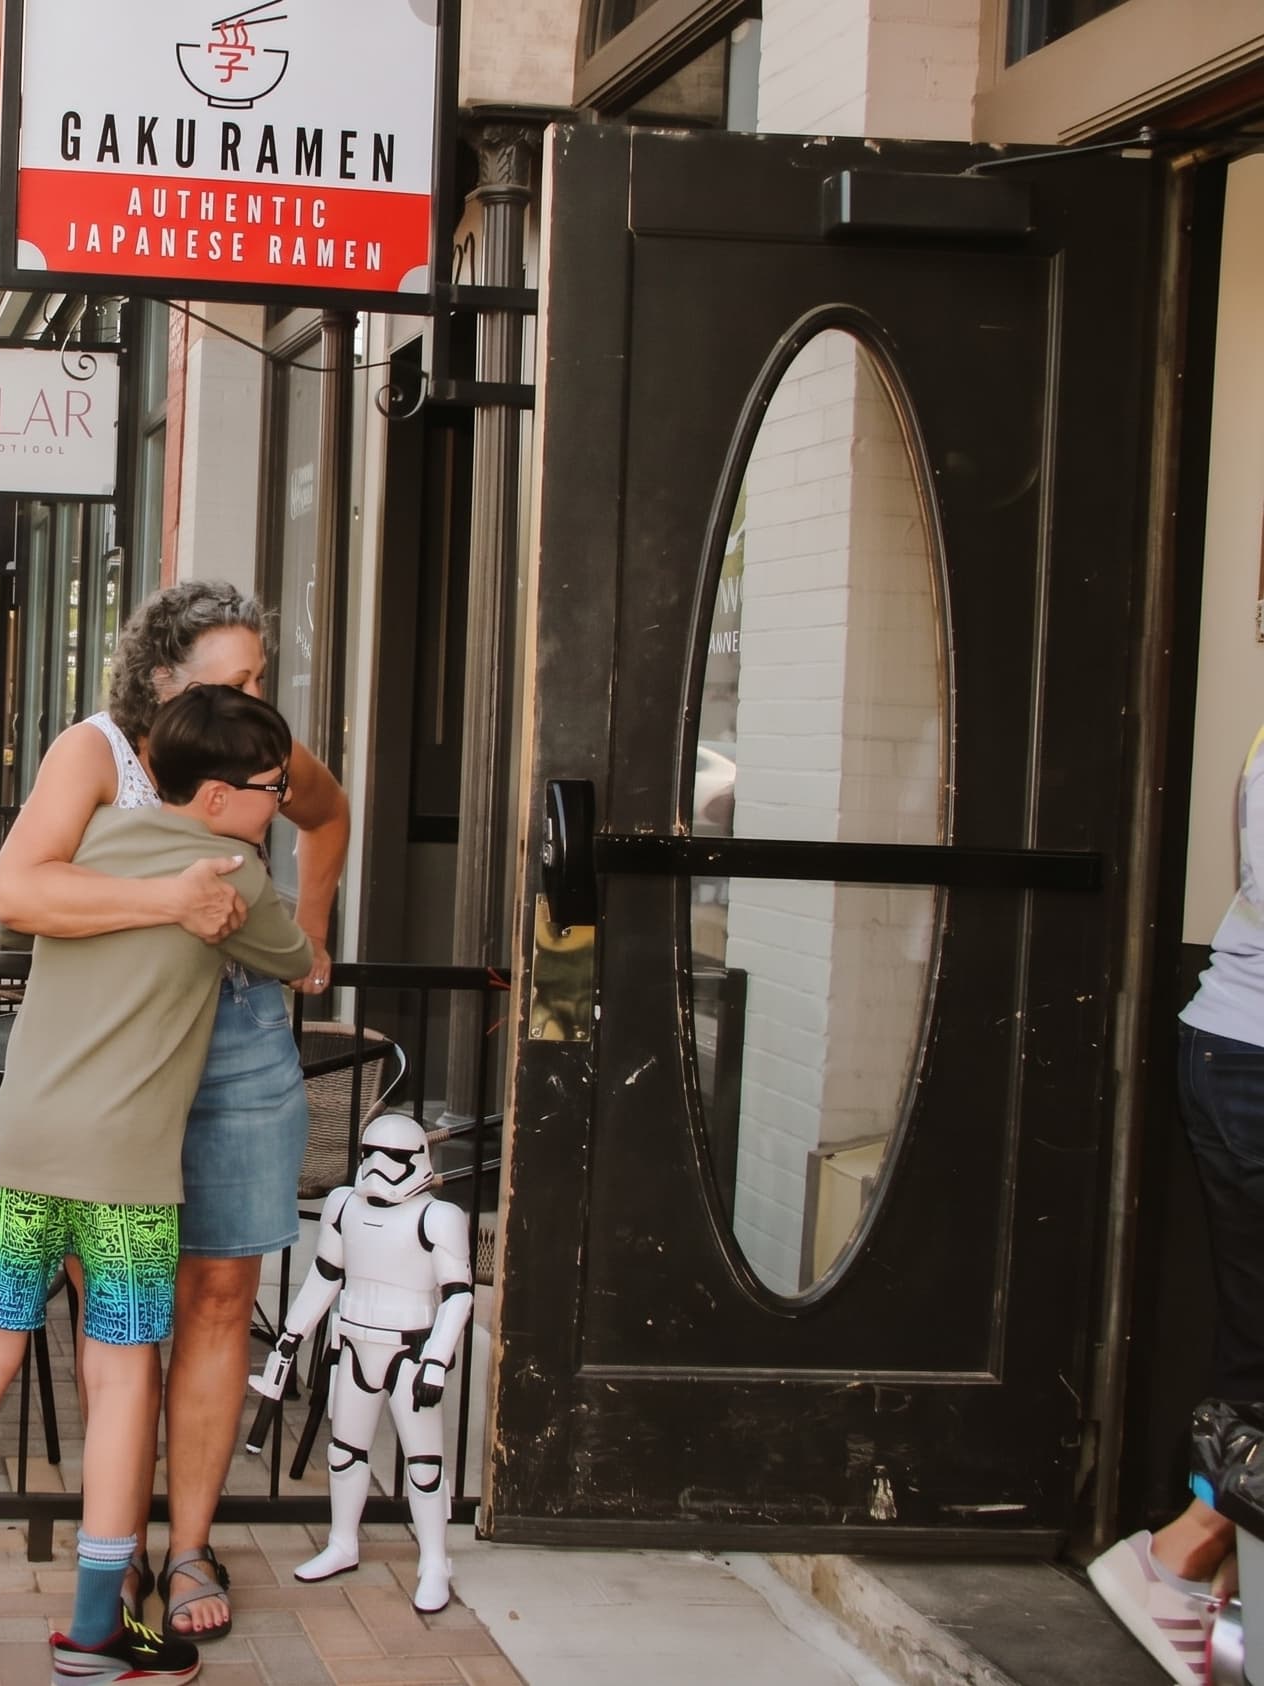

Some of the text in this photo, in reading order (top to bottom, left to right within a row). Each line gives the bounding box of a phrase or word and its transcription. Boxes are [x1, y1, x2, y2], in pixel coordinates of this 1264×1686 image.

[60, 110, 395, 183] GAKU RAMEN
[127, 187, 326, 229] AUTHENTIC
[67, 222, 382, 271] JAPANESE RAMEN
